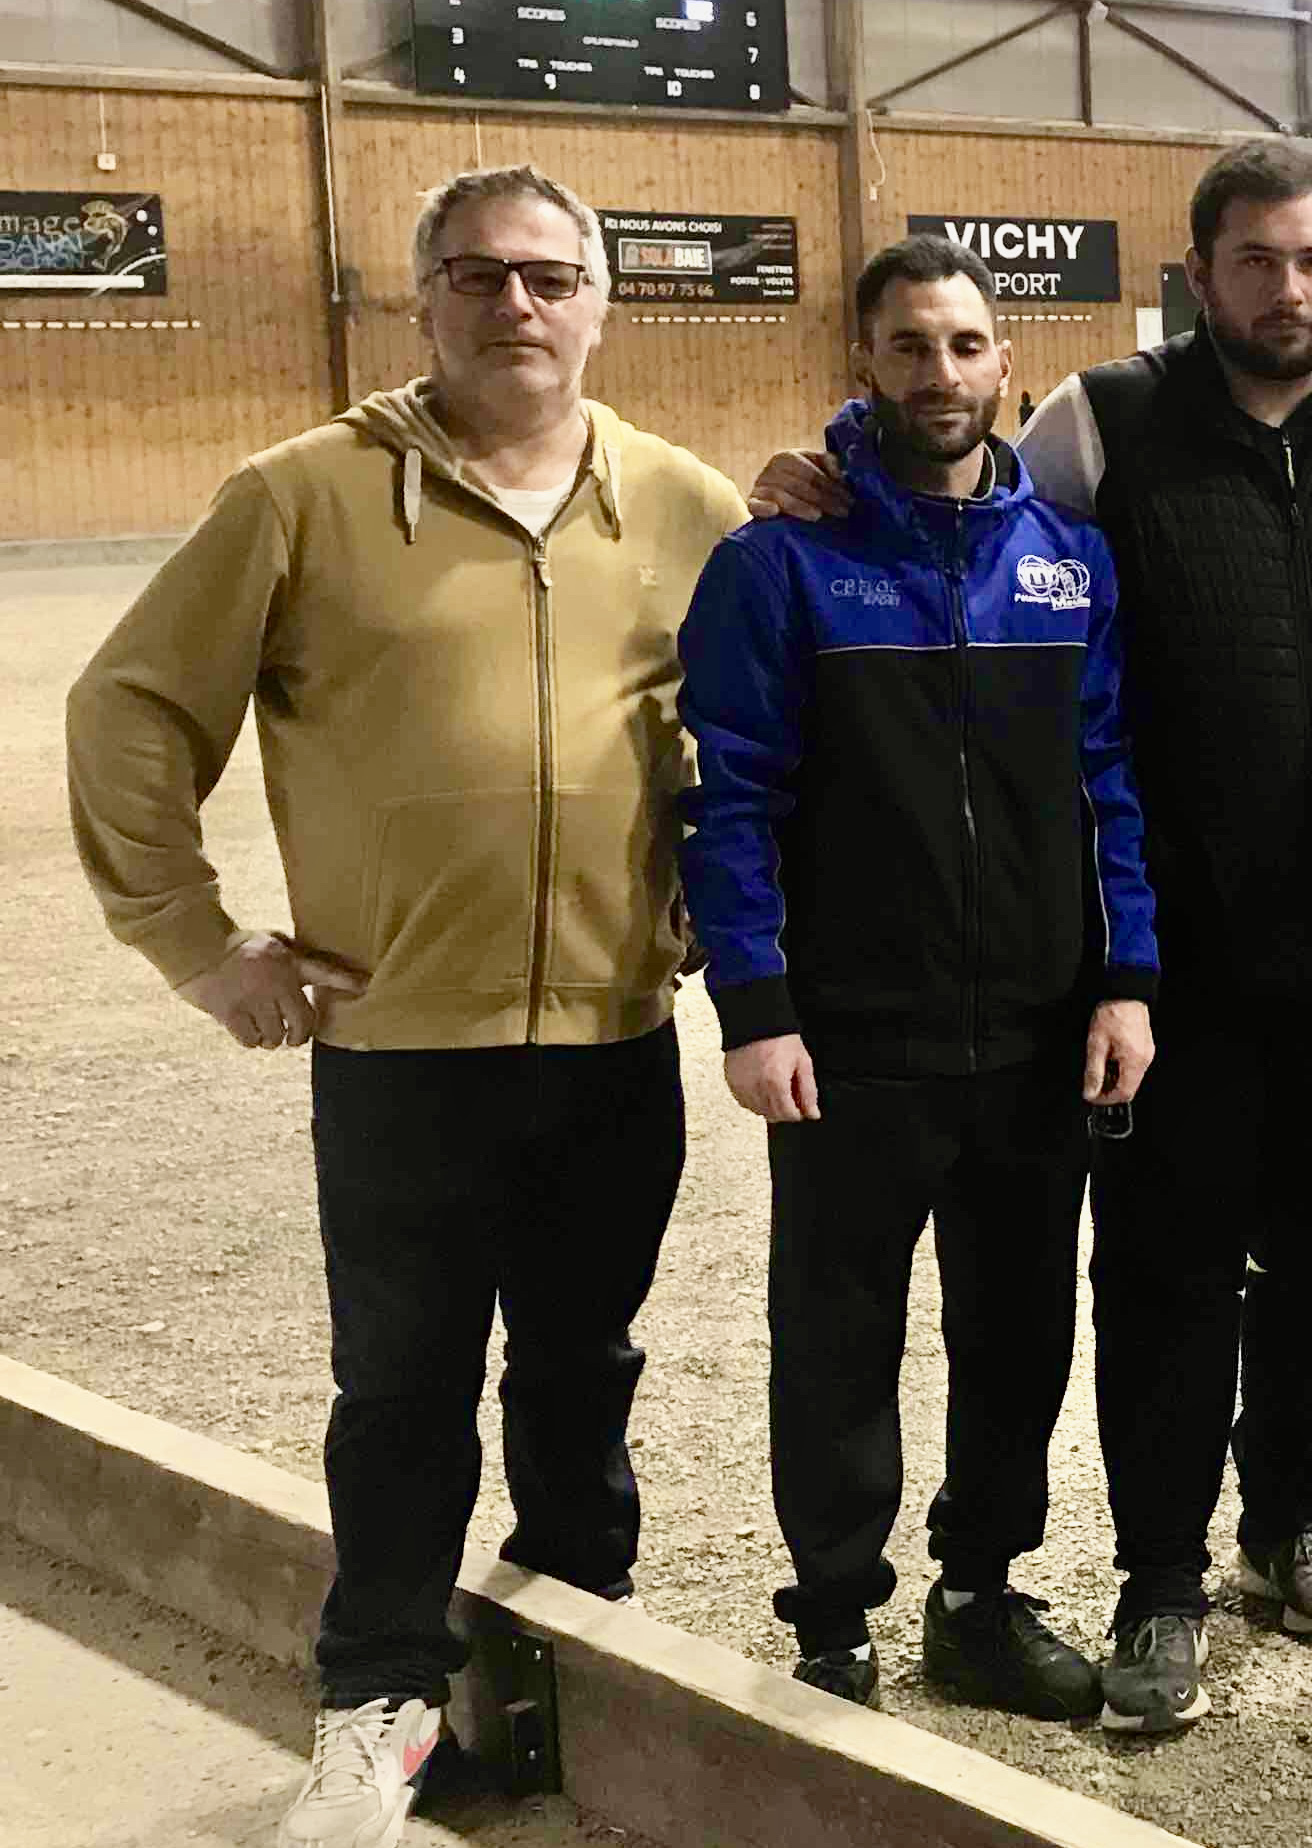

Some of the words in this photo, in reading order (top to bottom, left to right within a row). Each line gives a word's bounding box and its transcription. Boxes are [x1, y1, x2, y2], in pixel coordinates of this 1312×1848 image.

[745, 11, 757, 27] 6
[452, 27, 464, 44] 3
[748, 47, 758, 64] 7
[454, 67, 466, 83] 4
[544, 73, 557, 90] 9
[667, 80, 682, 97] 10
[620, 219, 650, 231] NOUS
[652, 220, 687, 233] AVONS
[944, 222, 1085, 260] VICHY
[618, 282, 635, 296] 04
[638, 282, 656, 296] 70
